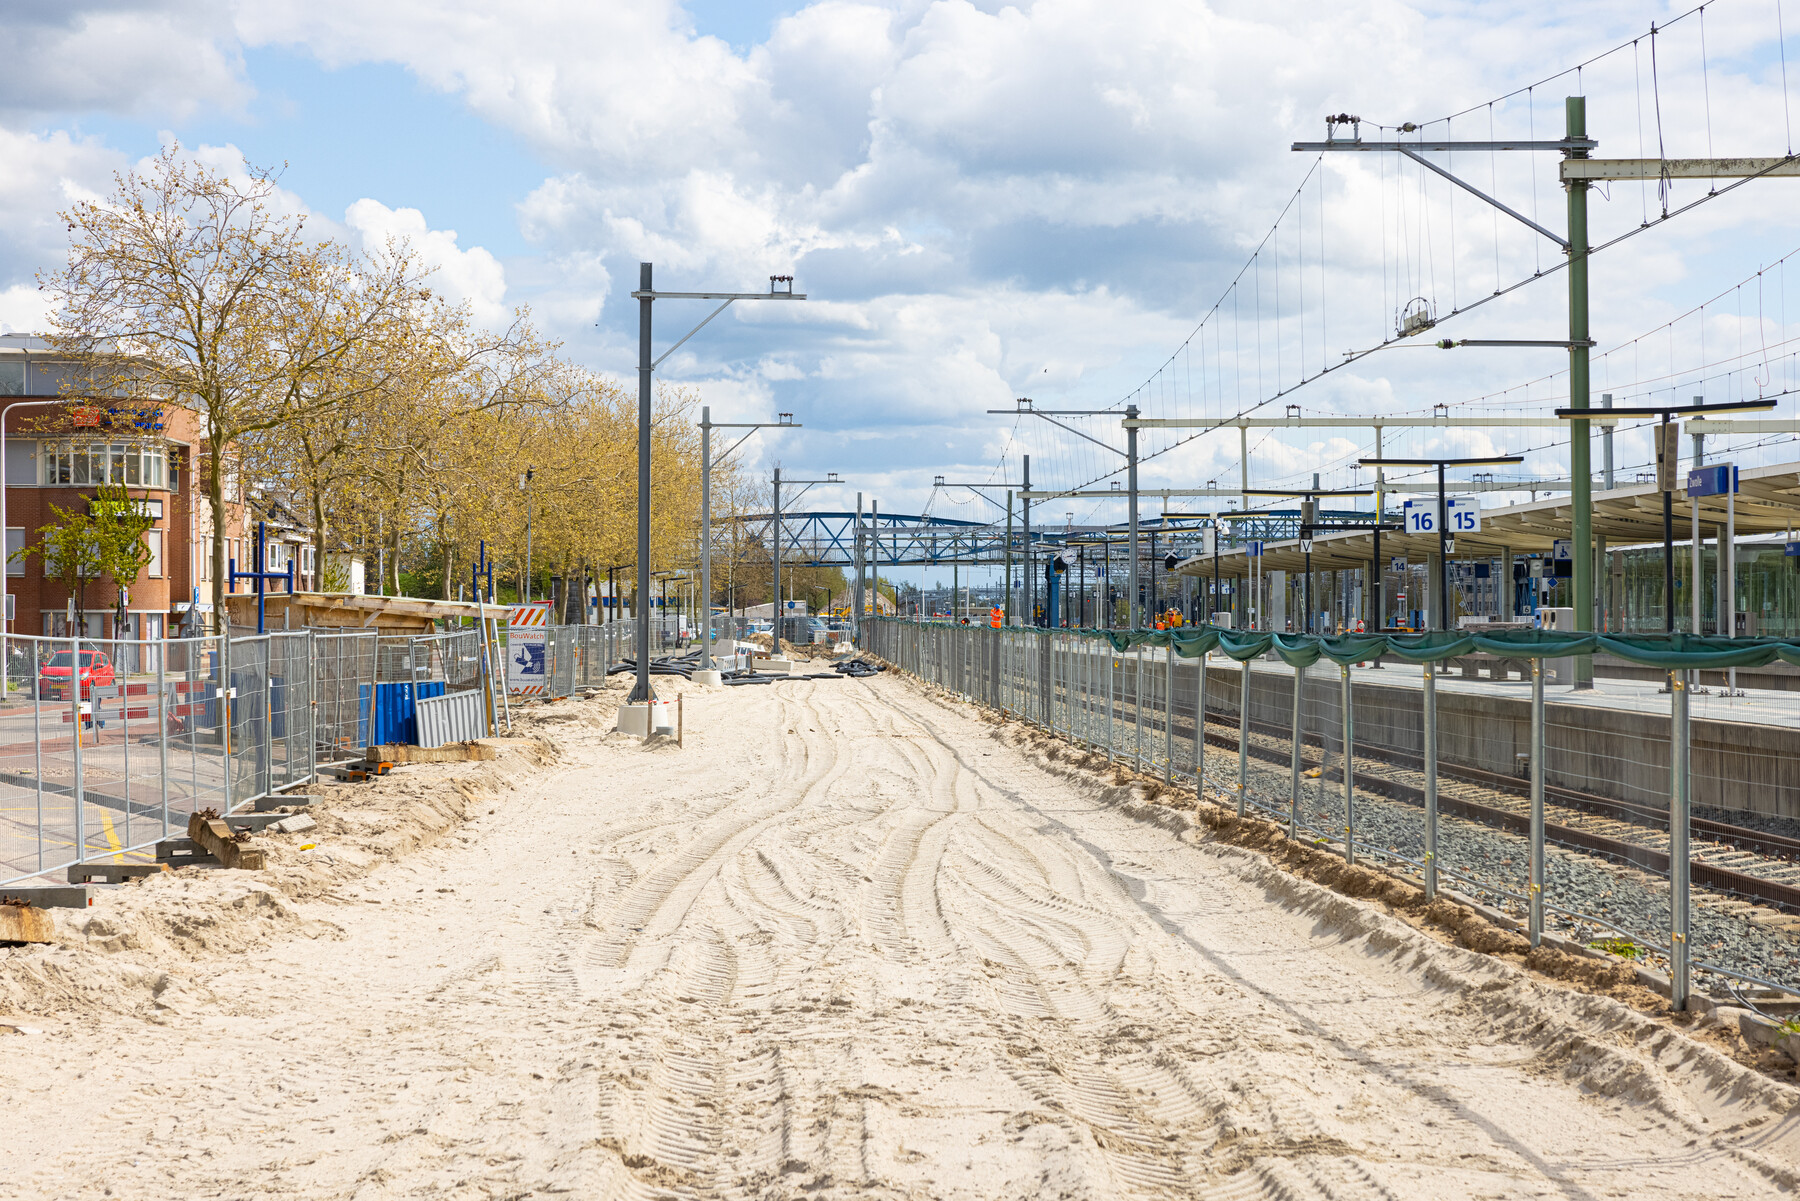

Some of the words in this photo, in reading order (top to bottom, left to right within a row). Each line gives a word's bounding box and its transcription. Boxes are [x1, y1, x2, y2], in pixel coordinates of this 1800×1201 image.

[1689, 475, 1703, 488] Zwolle
[1411, 512, 1433, 530] 16
[1453, 511, 1475, 529] 15
[1302, 540, 1311, 552] V
[1444, 540, 1453, 552] V
[1394, 562, 1405, 571] 14
[510, 632, 544, 640] BouWatch
